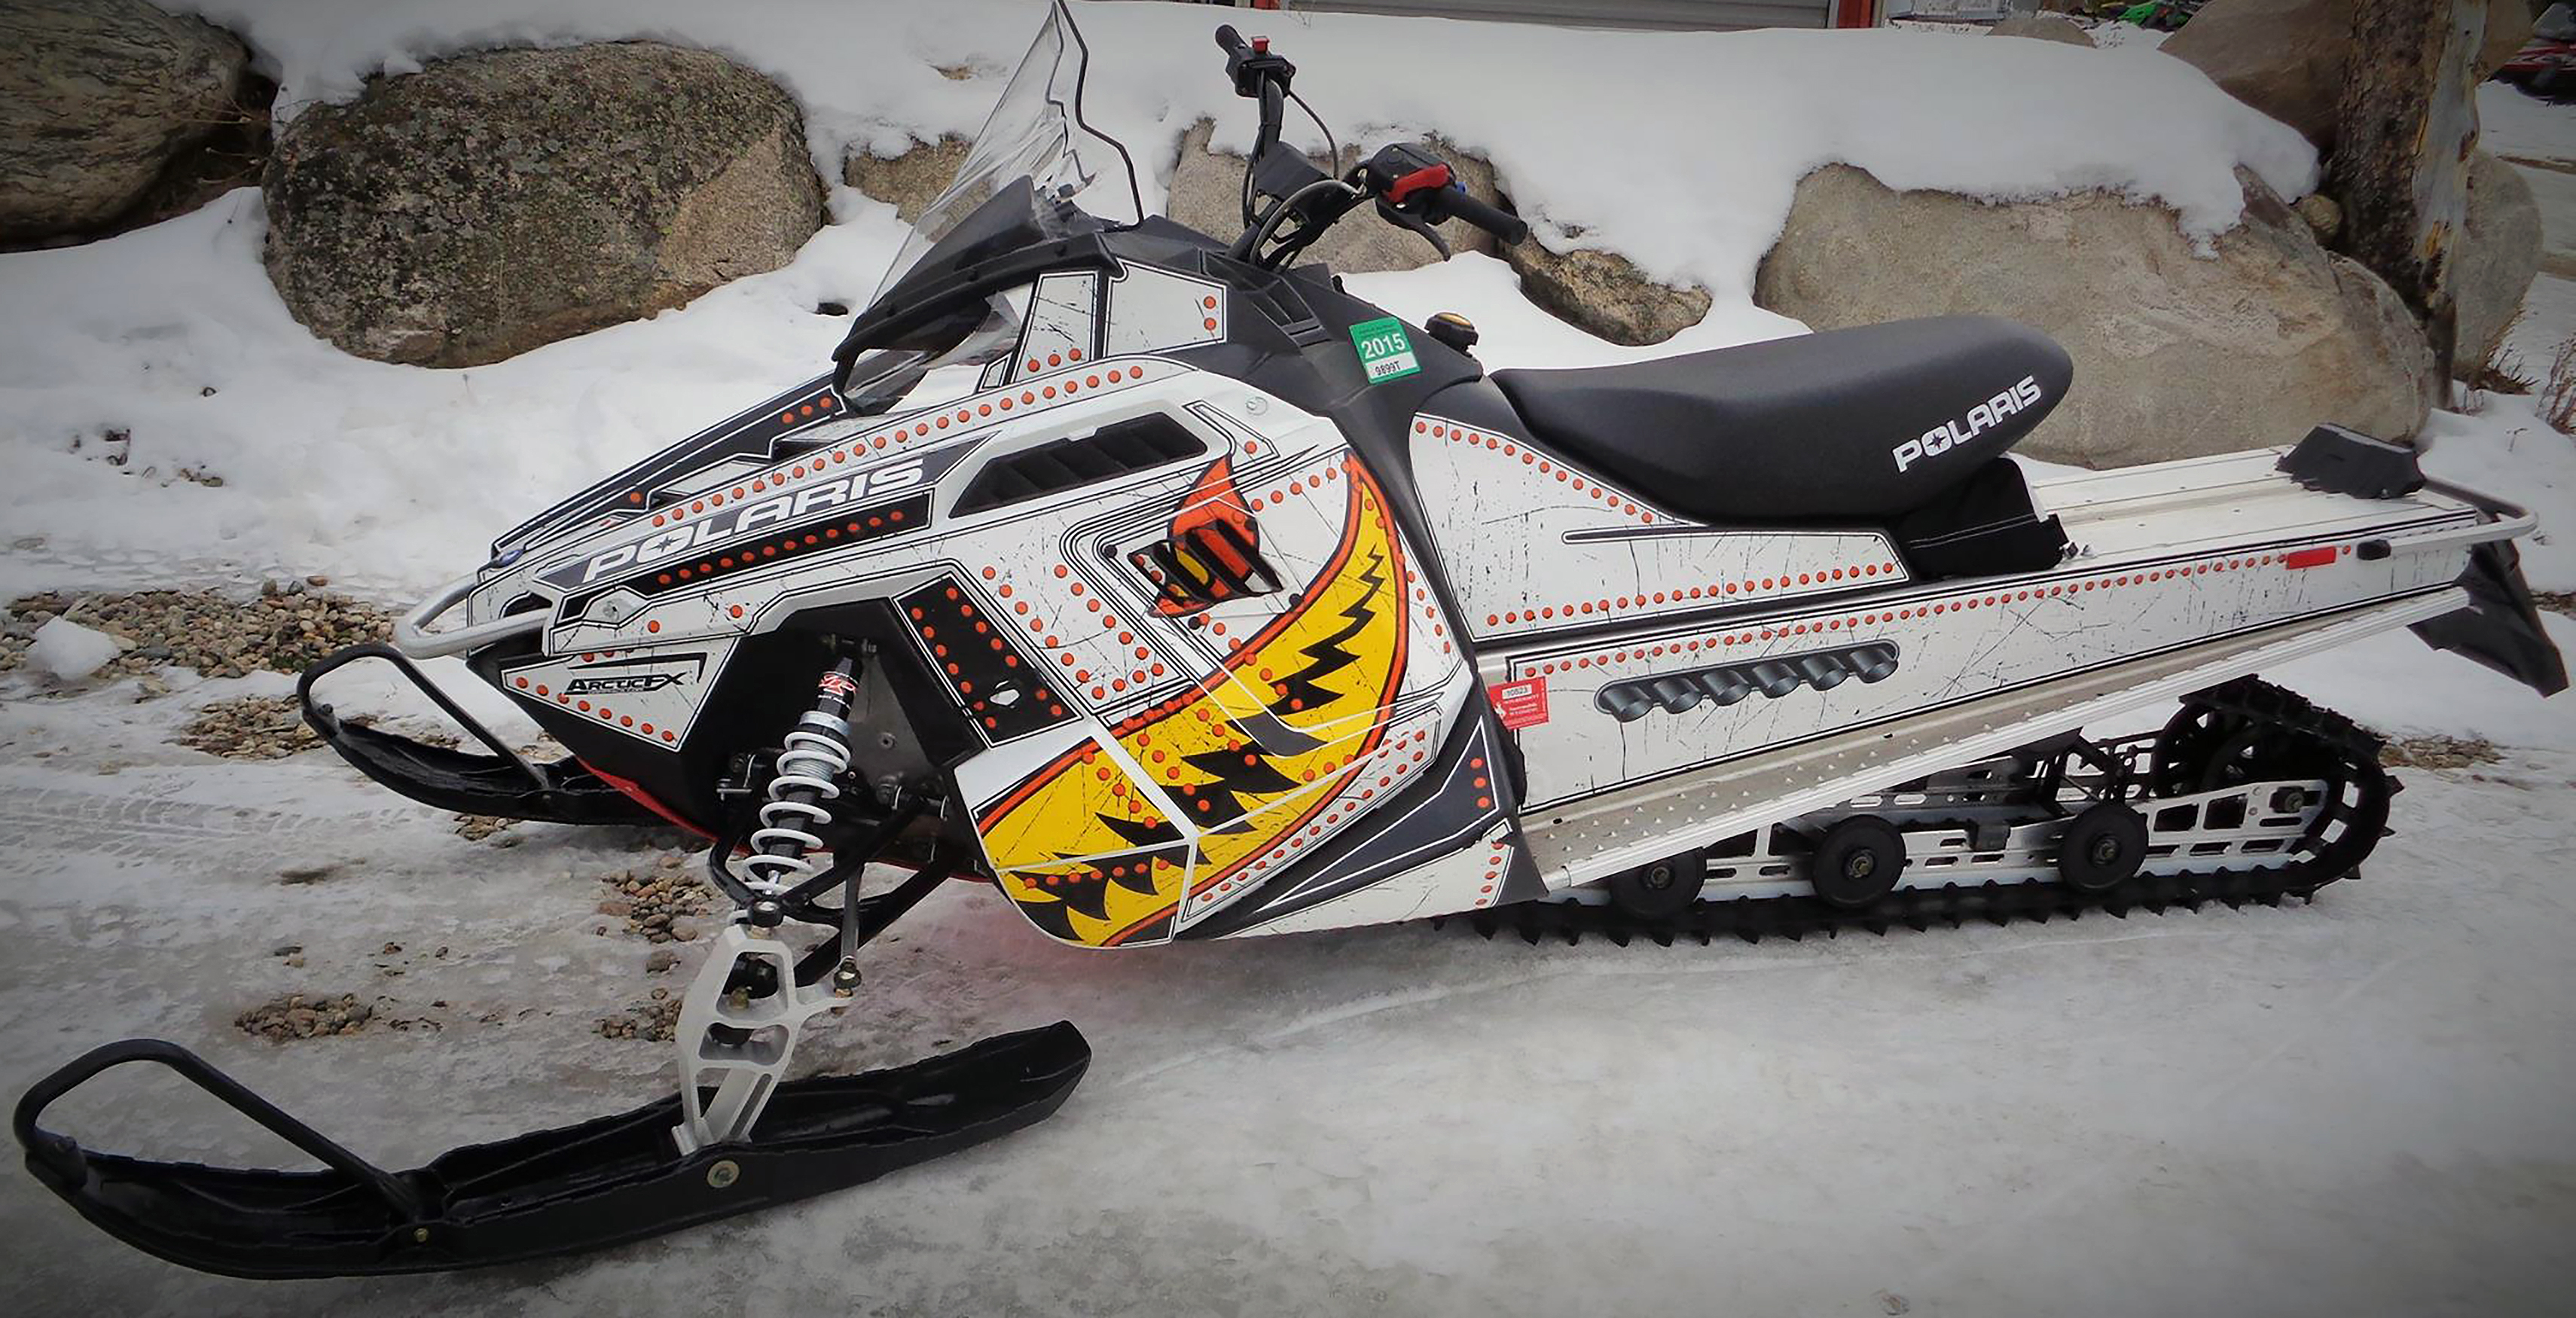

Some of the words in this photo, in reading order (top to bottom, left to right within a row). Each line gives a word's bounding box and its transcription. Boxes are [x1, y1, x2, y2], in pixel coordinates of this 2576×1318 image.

[1361, 333, 1406, 358] 2015
[1892, 375, 2042, 473] POLARIS
[582, 458, 923, 583] POLARIS
